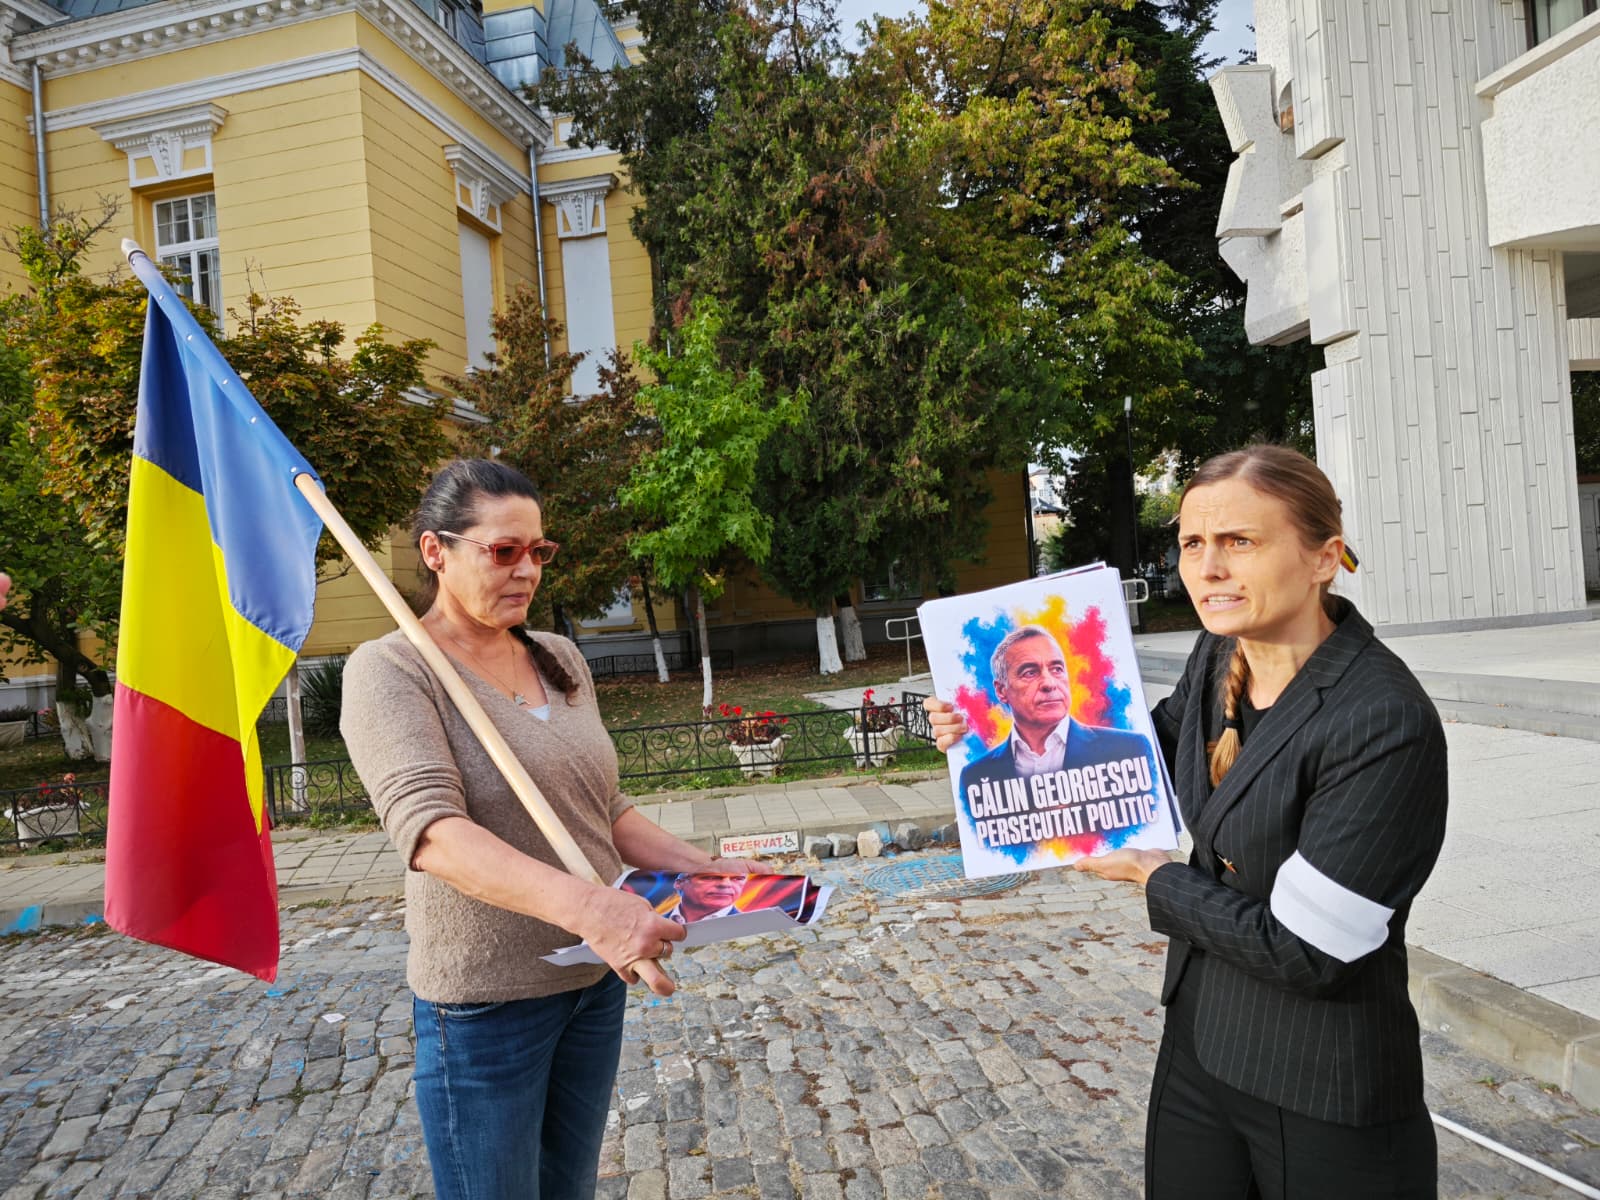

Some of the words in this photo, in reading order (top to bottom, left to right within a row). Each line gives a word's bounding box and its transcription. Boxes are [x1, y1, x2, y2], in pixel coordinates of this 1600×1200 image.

[967, 775, 1029, 818] CĂLIN
[1031, 757, 1151, 808] GEORGESCU
[723, 837, 783, 853] REZERVAT
[975, 807, 1086, 848] PERSECUTAT
[1089, 795, 1158, 832] POLITIC
